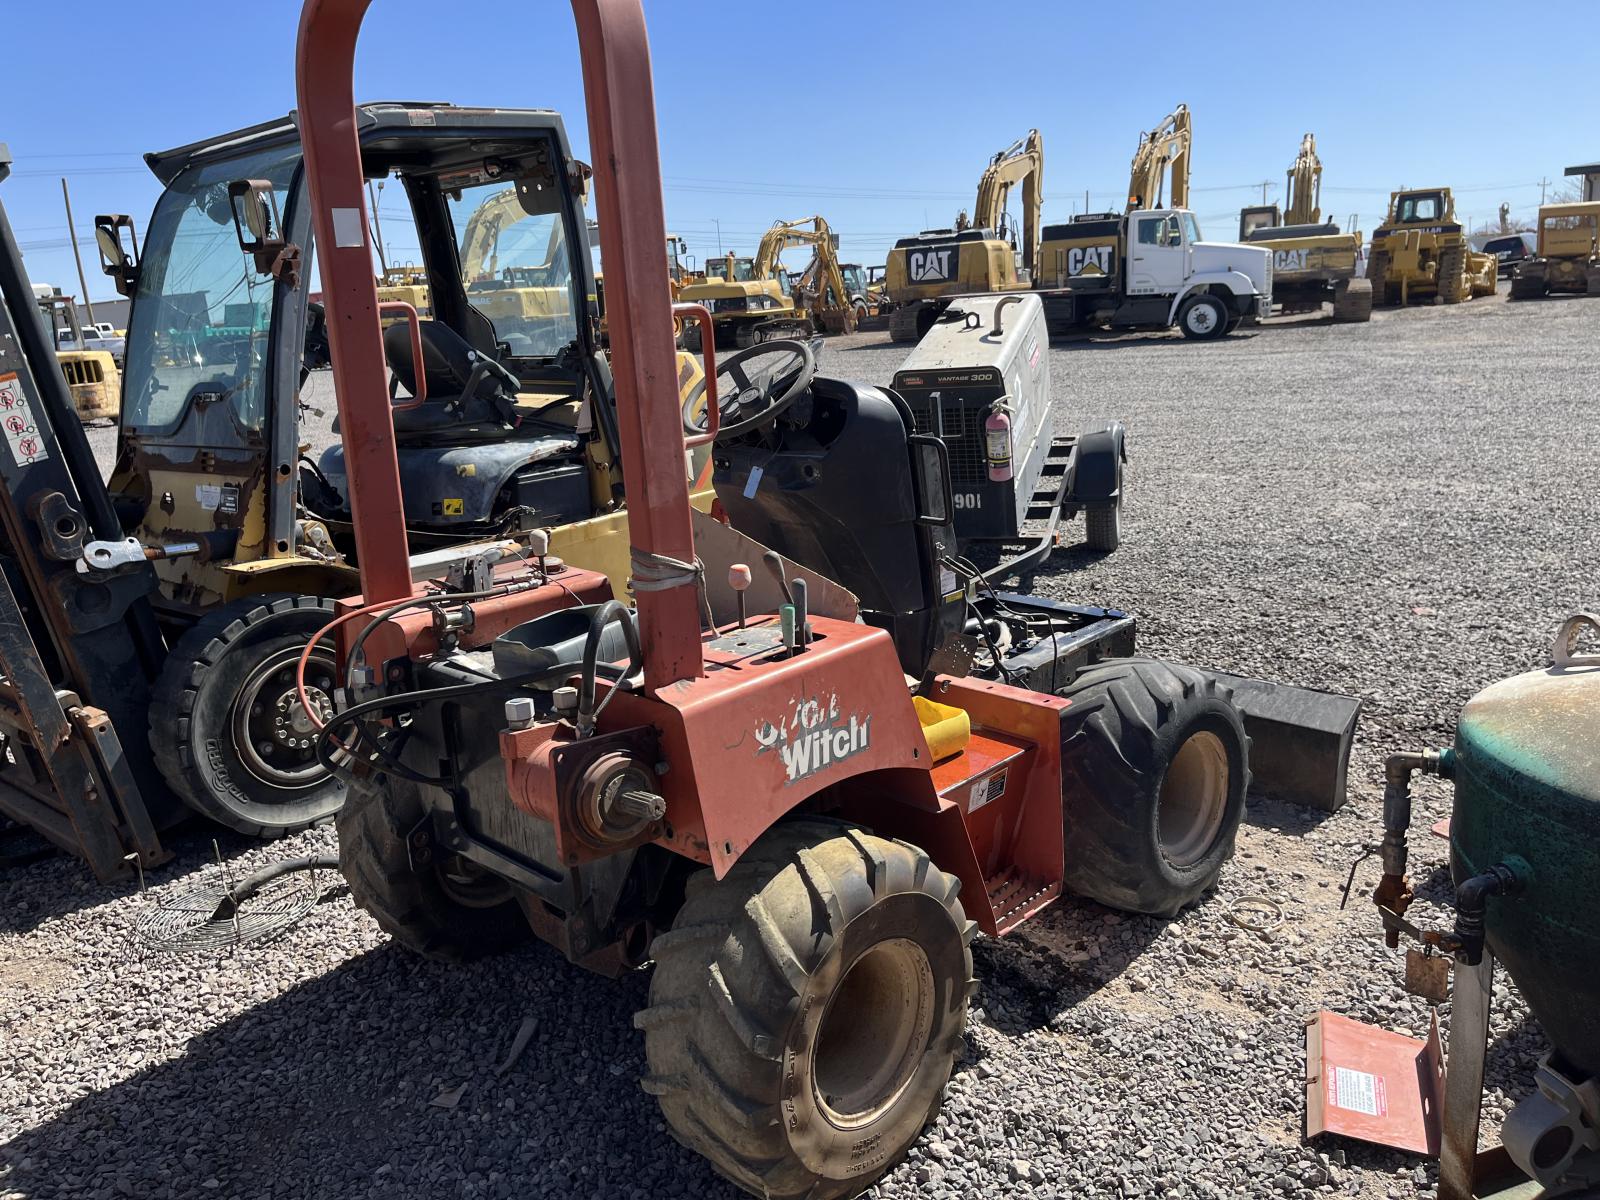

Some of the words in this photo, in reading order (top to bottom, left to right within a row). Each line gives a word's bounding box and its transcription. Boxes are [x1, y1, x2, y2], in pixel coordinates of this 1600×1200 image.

[910, 250, 952, 281] CAT
[1068, 246, 1113, 276] CAT
[1274, 248, 1310, 270] CAT
[970, 373, 992, 381] 300
[782, 714, 868, 780] Witch
